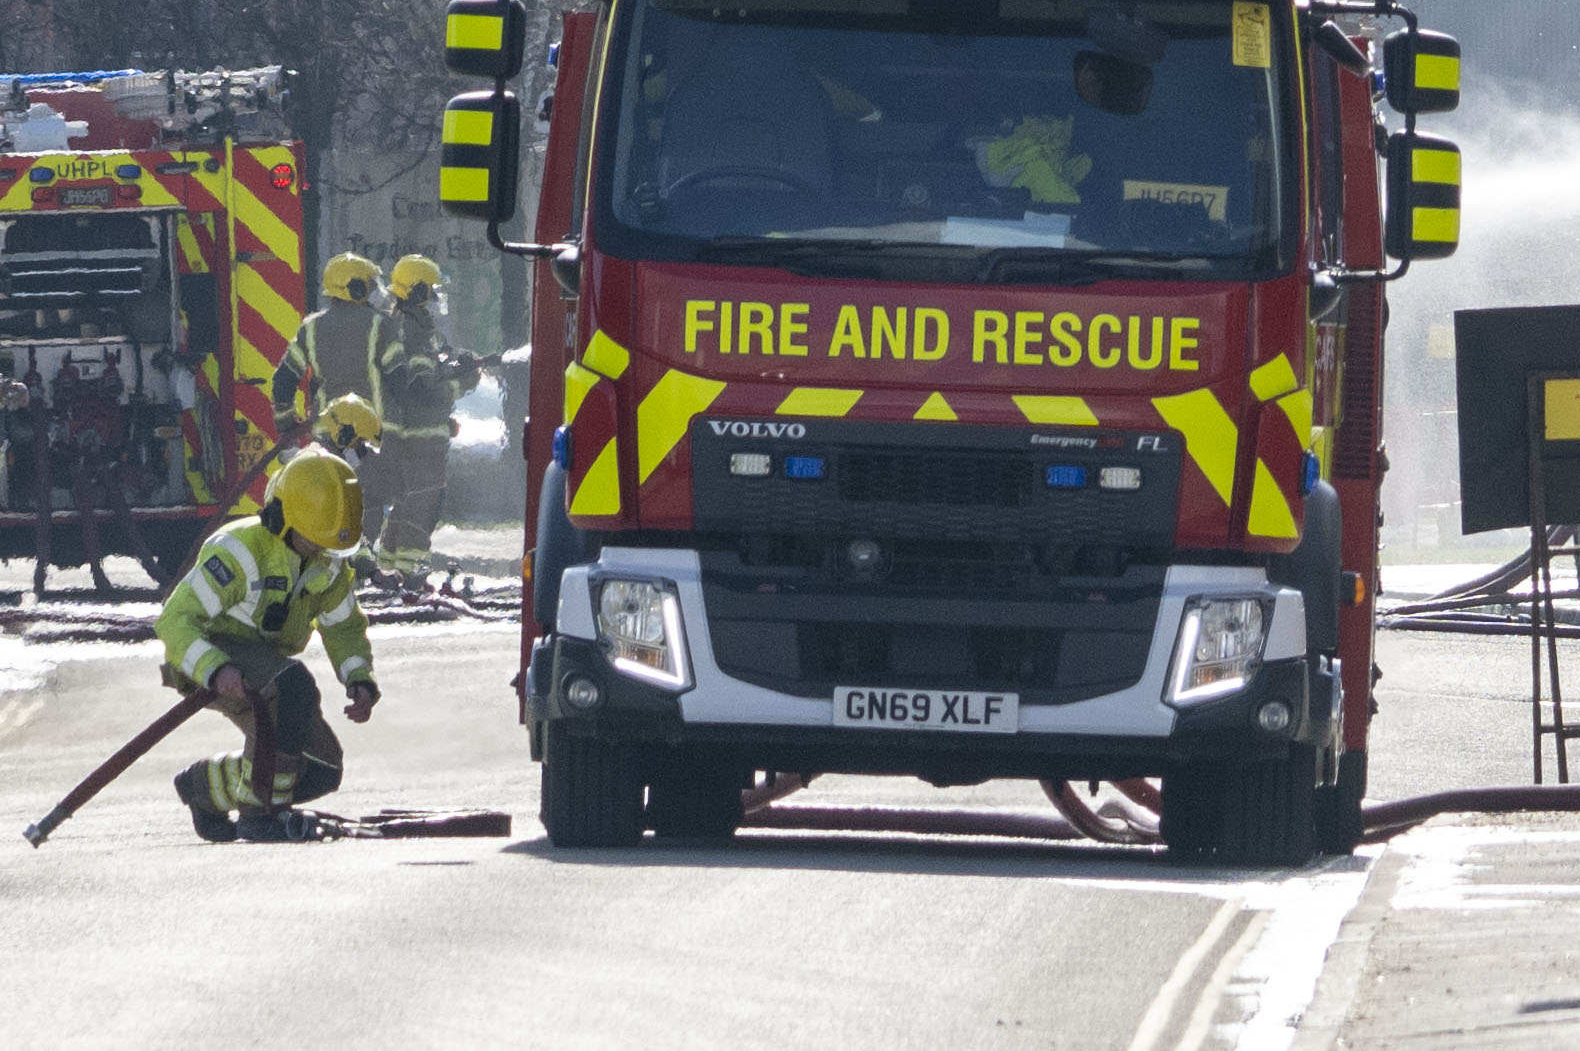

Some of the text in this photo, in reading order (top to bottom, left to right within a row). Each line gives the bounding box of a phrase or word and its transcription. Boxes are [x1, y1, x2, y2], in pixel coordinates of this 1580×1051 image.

[57, 160, 112, 178] UHPL
[684, 300, 1201, 370] FIRE AND RESCUE
[707, 420, 806, 439] VOLVO
[1030, 434, 1098, 449] Emergency
[1137, 435, 1169, 451] FL
[846, 690, 1004, 726] GN69 XLF
